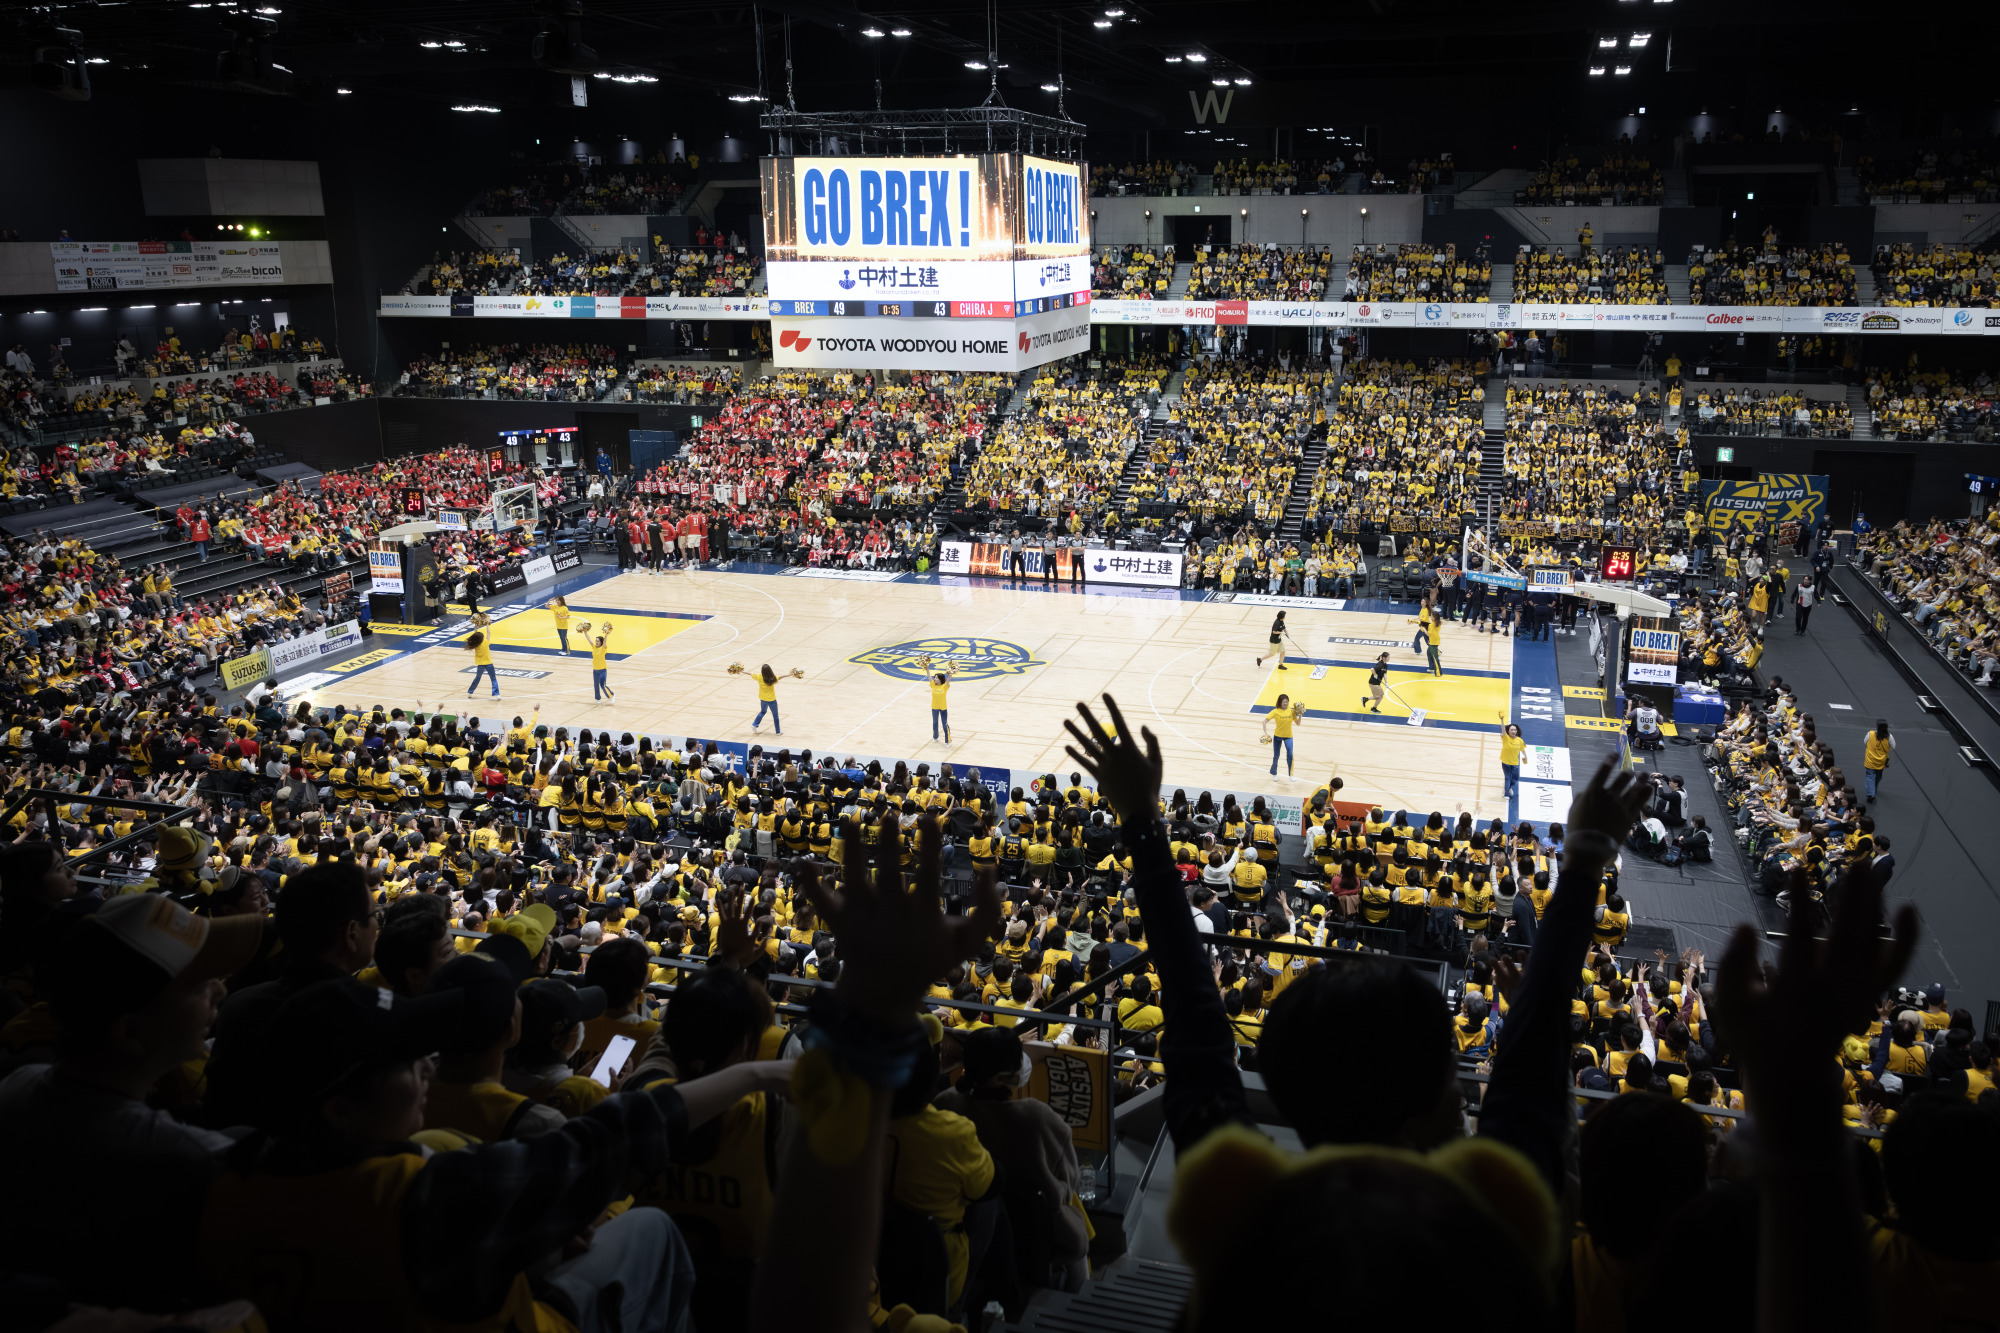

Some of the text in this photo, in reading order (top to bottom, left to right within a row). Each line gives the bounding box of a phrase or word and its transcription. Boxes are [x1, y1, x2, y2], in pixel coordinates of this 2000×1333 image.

[1188, 89, 1235, 124] W
[803, 168, 970, 247] GO BREX!
[1027, 166, 1079, 245] GO BREX!
[252, 266, 282, 276] bicoh
[858, 266, 939, 288] 中村土建
[1046, 262, 1071, 283] 中村土建
[91, 277, 113, 285] KOBO
[794, 302, 994, 316] BREX 49 0:35 43 CHIBA J
[1195, 307, 1214, 319] FKD
[1282, 308, 1312, 318] UACJ
[1706, 313, 1744, 324] Calbee
[1823, 312, 1861, 322] RISE
[1914, 317, 1941, 325] Shinryo
[1032, 333, 1051, 349] TOYOTA
[1075, 324, 1089, 338] HOME
[817, 337, 1009, 354] TOYOTA WOODYOU HOME
[506, 436, 518, 446] 49
[559, 432, 571, 442] 43
[491, 459, 502, 472] 24
[1968, 480, 1982, 493] 49
[407, 499, 421, 511] 24
[439, 512, 447, 523] GO
[370, 551, 400, 567] GO BREX!
[1612, 551, 1630, 561] 0:35
[556, 556, 580, 571] B.LEAGUE
[1109, 557, 1174, 575] 中村土建
[1608, 561, 1630, 575] 24
[501, 573, 524, 586] SoftBank
[1535, 571, 1568, 585] GO BREX!
[397, 626, 427, 635] OUT
[1632, 630, 1678, 651] GO BREX!
[340, 651, 391, 670] MANI
[876, 647, 1024, 663] UTSUNOMIYA
[231, 660, 267, 681] SUZUSAN
[1640, 668, 1671, 678] 中村土建
[1520, 687, 1553, 722] BREX
[1575, 719, 1620, 728] KEEP
[1006, 843, 1019, 856] 25
[1037, 851, 1044, 863] 6
[1244, 868, 1253, 881] 6
[1473, 901, 1483, 913] 6
[1904, 1056, 1915, 1074] 6
[1045, 1055, 1070, 1121] OGAW
[1063, 1053, 1092, 1128] ATSUYA
